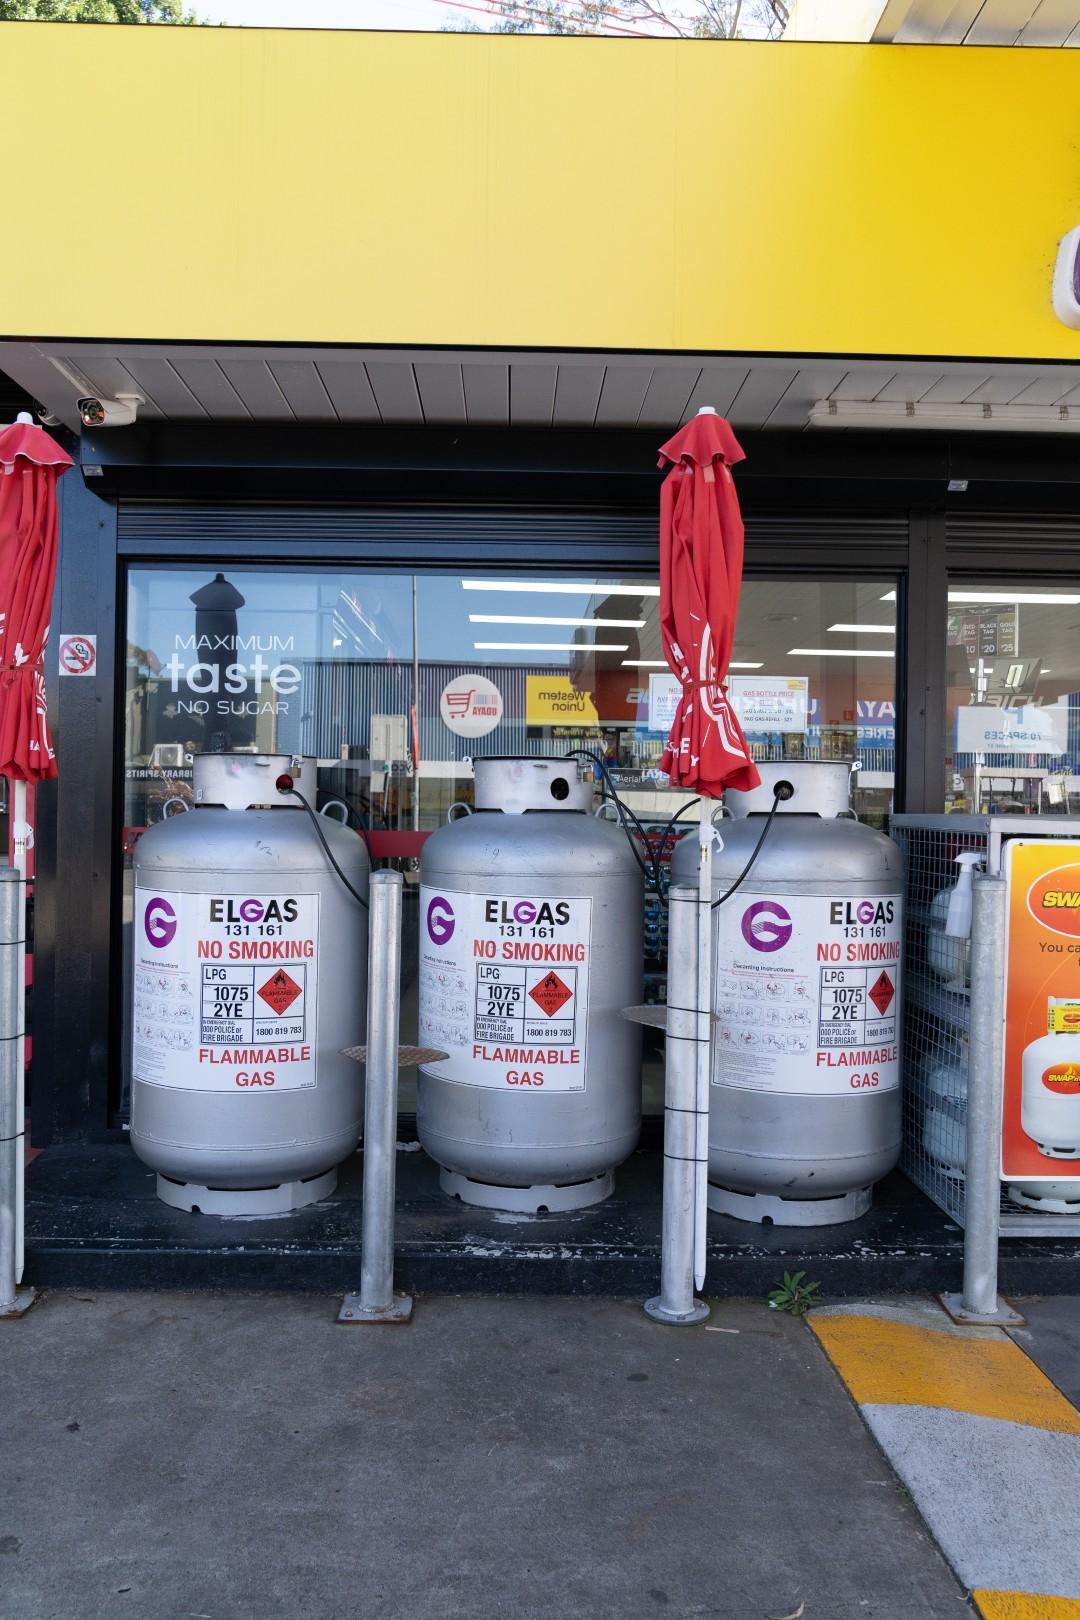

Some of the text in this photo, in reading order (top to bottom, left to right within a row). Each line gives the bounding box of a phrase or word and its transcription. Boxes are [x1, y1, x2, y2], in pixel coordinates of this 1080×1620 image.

[175, 634, 294, 650] MAXIMUM
[166, 653, 302, 694] taste
[177, 700, 289, 714] NO SUGAR
[1042, 891, 1080, 908] SW
[210, 898, 298, 923] ELGAS
[485, 900, 570, 925] ELGAS
[830, 900, 894, 925] ELGAS
[225, 925, 282, 936] 131 161
[499, 926, 554, 938] 131 161
[843, 926, 886, 938] 131 161
[198, 939, 314, 959] NO SMOKING
[473, 940, 585, 962] NO SMOKING
[817, 941, 900, 961] NO SMOKING
[1039, 942, 1064, 953] You
[205, 968, 226, 980] LPG
[480, 968, 500, 979] LPG
[824, 971, 844, 982] LPG
[215, 987, 248, 1001] 1075
[487, 986, 520, 1001] 1075
[832, 989, 862, 1003] 1075
[214, 1004, 243, 1017] 2YE
[487, 1001, 515, 1017] 2YE
[832, 1006, 858, 1020] 2YE
[256, 1028, 273, 1036] 1800
[290, 1026, 302, 1034] 783
[489, 1032, 514, 1041] BRIGADE
[199, 1046, 311, 1064] FLAMMABLE
[473, 1045, 580, 1064] FLAMMABLE
[817, 1046, 897, 1067] FLAMMABLE
[236, 1072, 275, 1086] GAS
[506, 1070, 544, 1085] GAS
[850, 1072, 879, 1088] GAS
